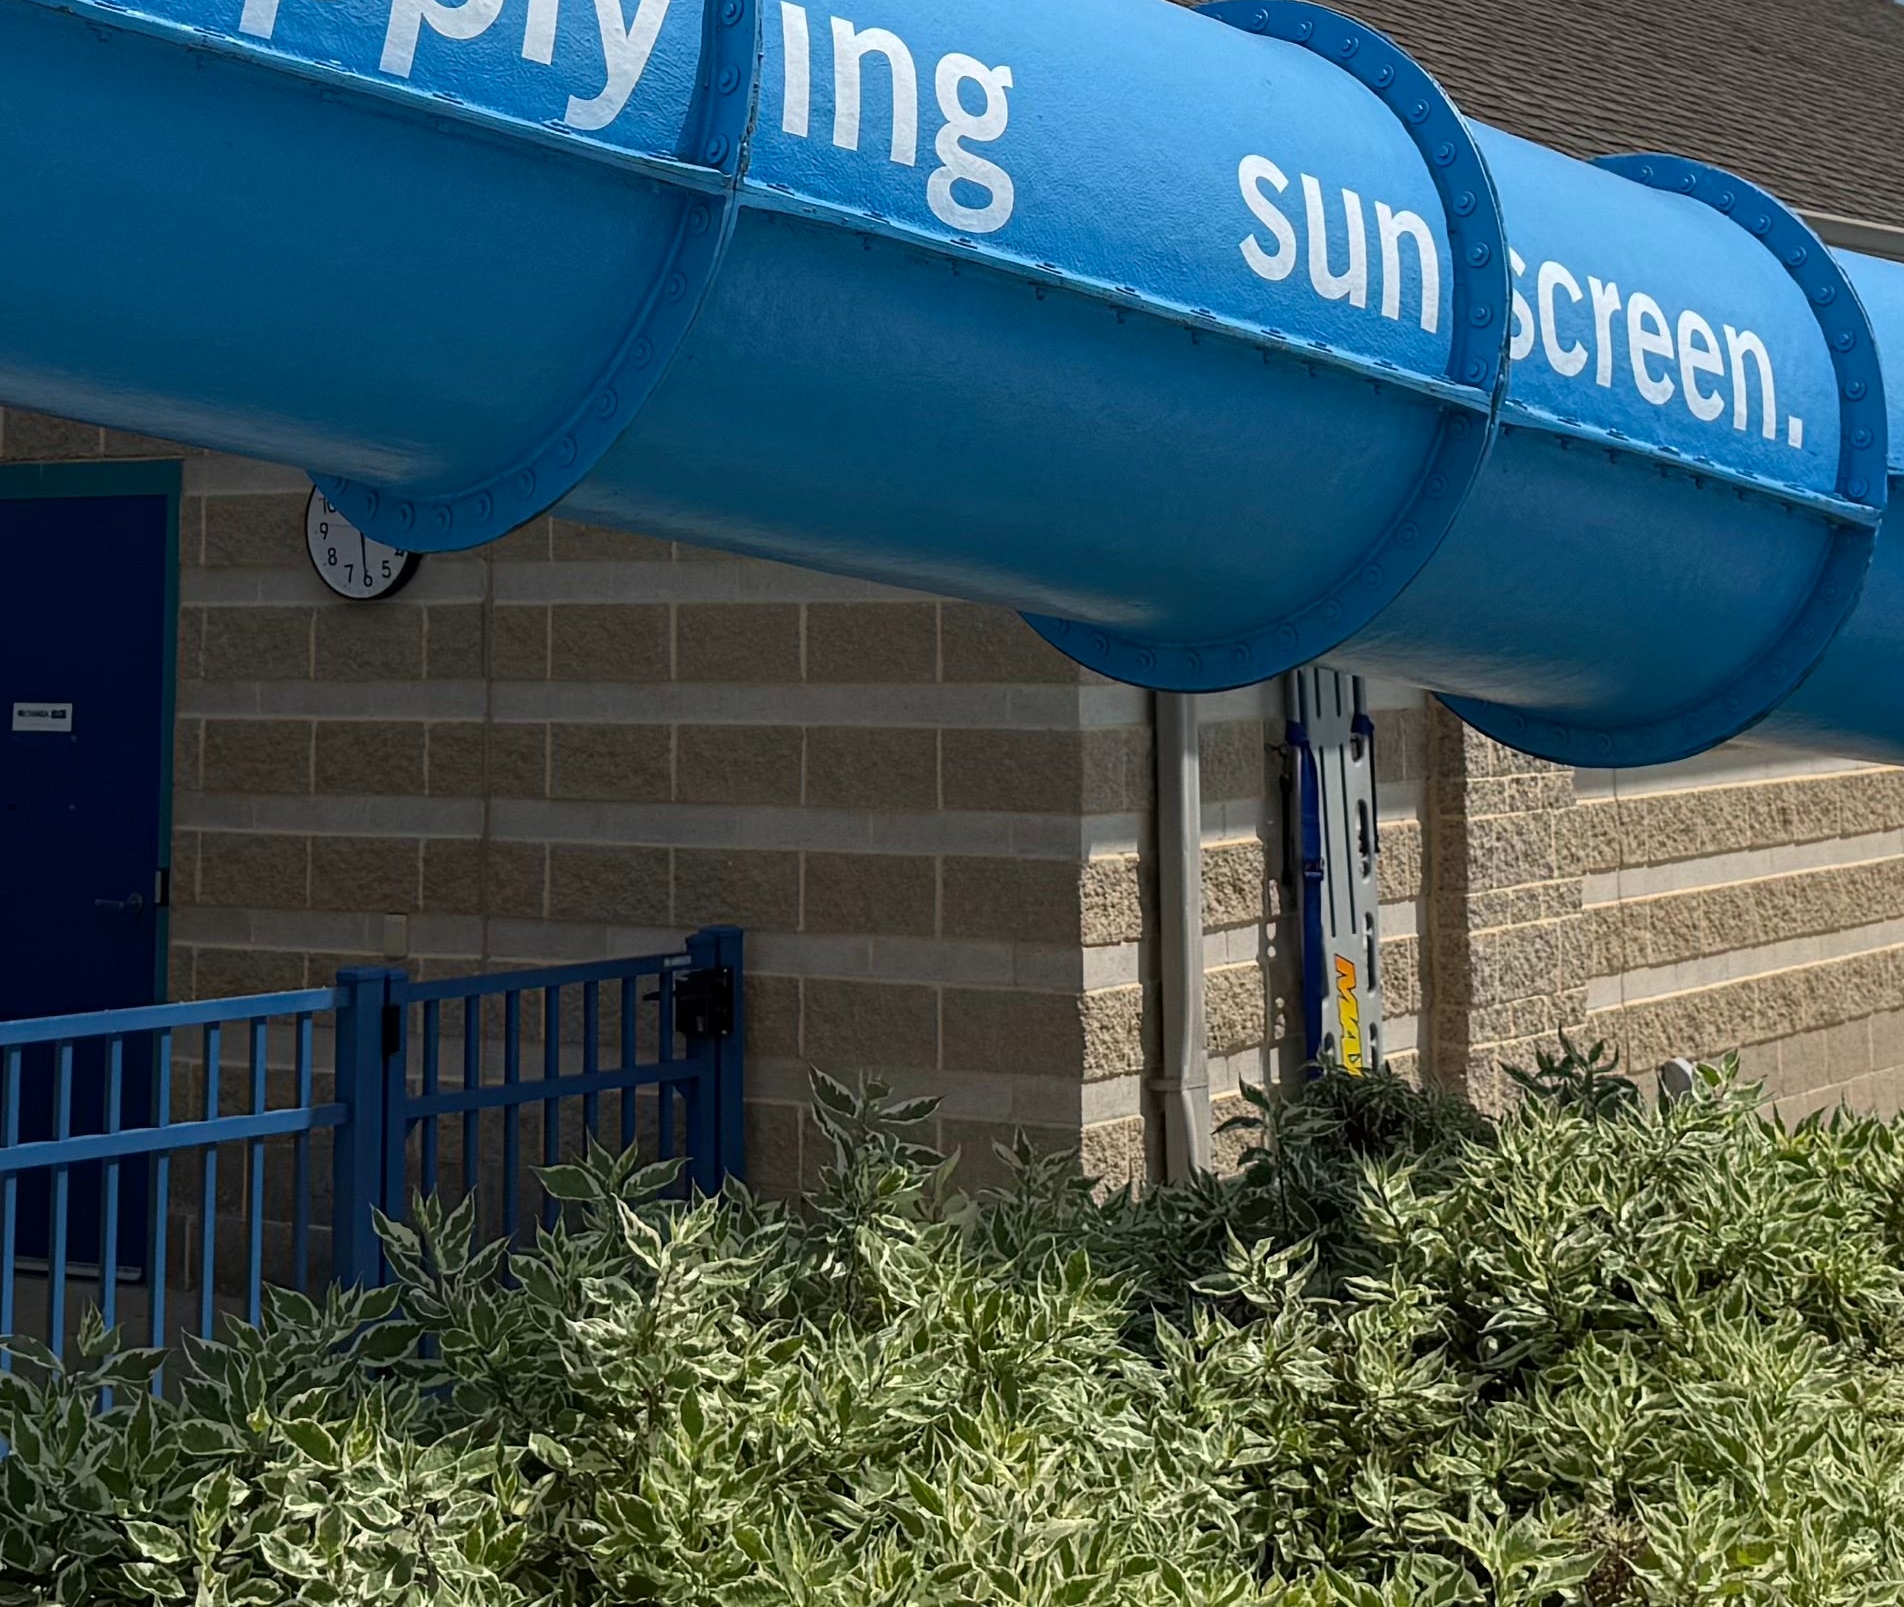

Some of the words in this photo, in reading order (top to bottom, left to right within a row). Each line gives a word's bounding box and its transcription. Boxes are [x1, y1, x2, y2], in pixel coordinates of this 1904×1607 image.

[319, 522, 329, 540] 9
[327, 547, 338, 566] 8
[344, 564, 354, 584] 7
[381, 560, 392, 578] 5
